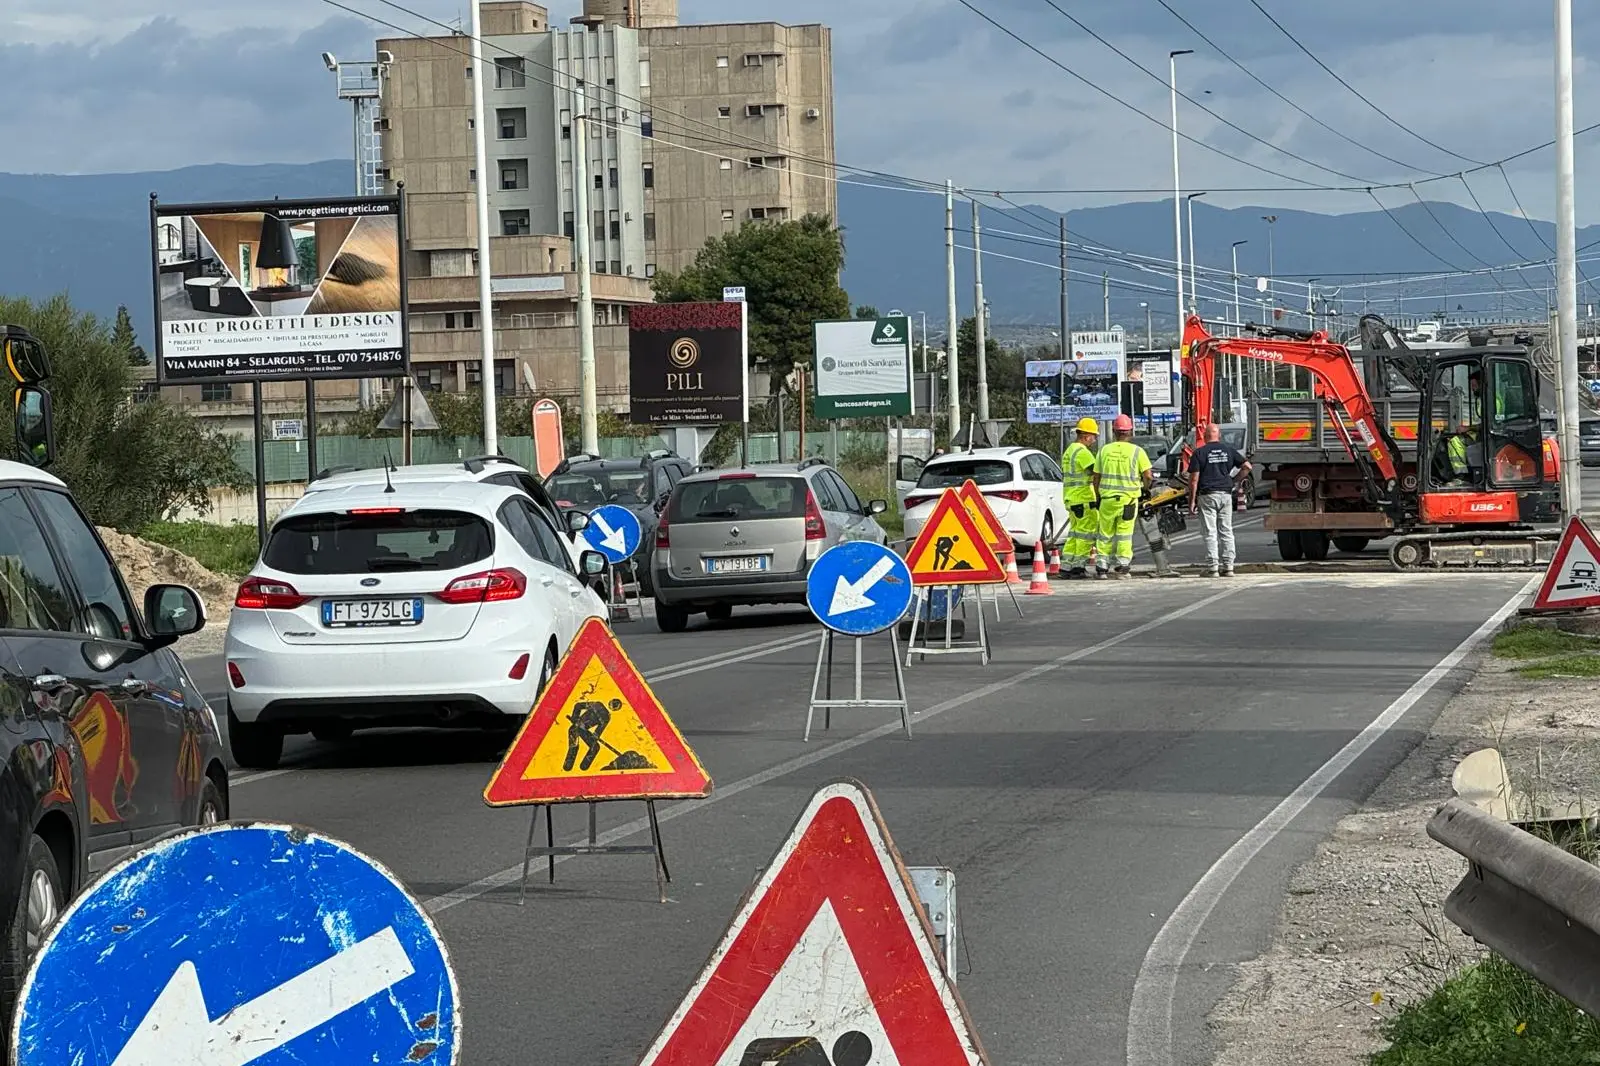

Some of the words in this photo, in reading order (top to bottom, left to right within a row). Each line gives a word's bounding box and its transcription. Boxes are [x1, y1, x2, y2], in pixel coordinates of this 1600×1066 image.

[278, 204, 389, 217] www.progettienergetici.com
[170, 321, 208, 334] RMC
[216, 317, 304, 332] PROGETTI
[314, 317, 322, 328] E
[330, 313, 394, 327] DESIGN
[213, 336, 262, 344] RISCALDAMENTO
[1248, 347, 1283, 360] Kubota
[166, 360, 185, 370] VIA
[187, 359, 224, 369] MANIN
[226, 358, 240, 367] 84
[249, 355, 305, 366] SELARGIUS
[314, 354, 335, 364] TEL.
[337, 353, 357, 363] 070
[360, 351, 401, 362] 7541876
[837, 360, 860, 368] Banco
[860, 359, 867, 367] di
[868, 358, 902, 368] Sardegna
[666, 373, 704, 390] PILI
[834, 399, 892, 408] bancosardegna.it
[1300, 478, 1307, 487] 70
[1470, 504, 1503, 512] U36-4
[361, 601, 411, 618] 973LG
